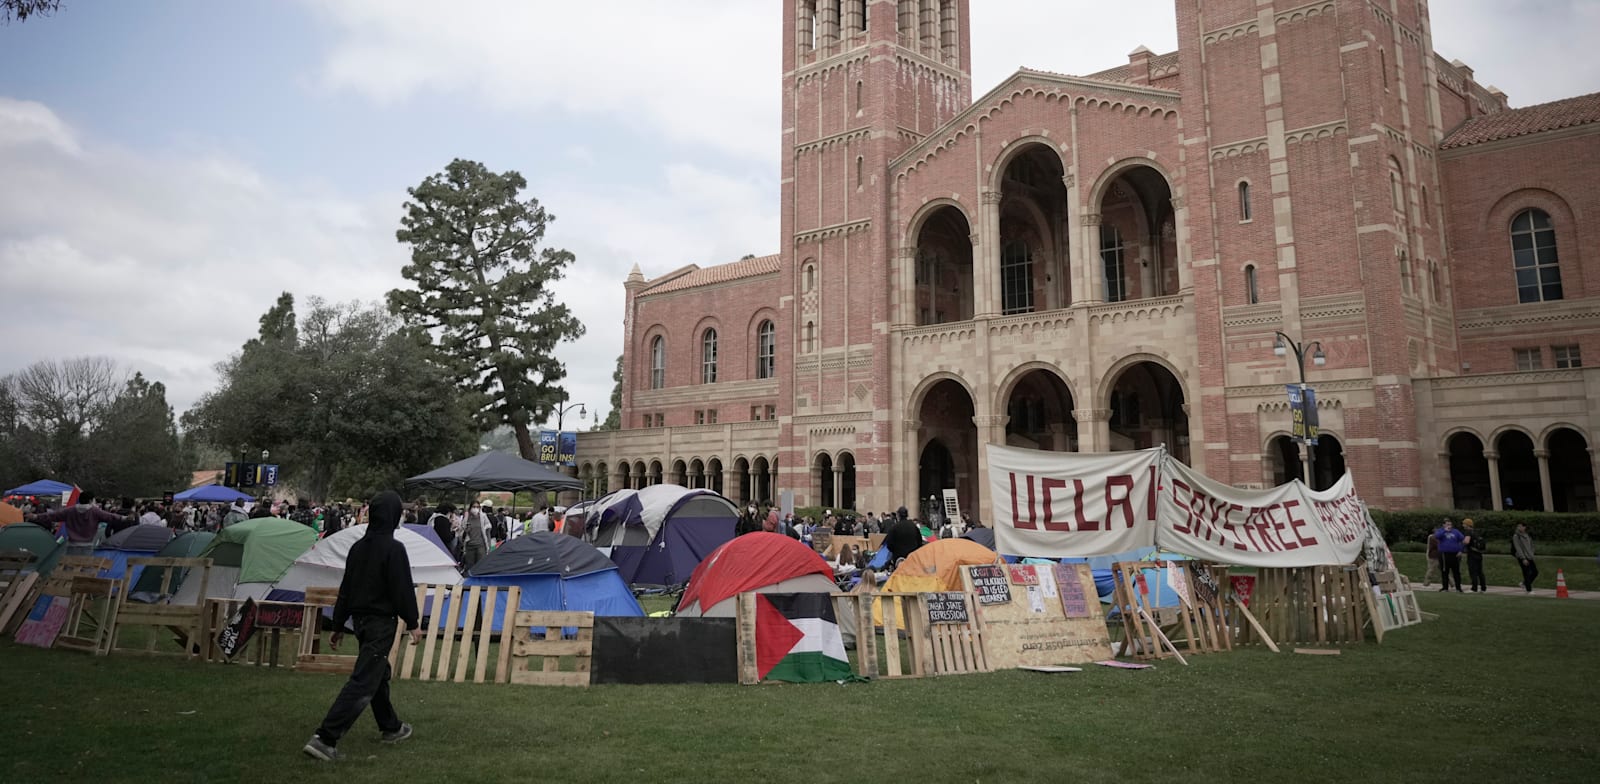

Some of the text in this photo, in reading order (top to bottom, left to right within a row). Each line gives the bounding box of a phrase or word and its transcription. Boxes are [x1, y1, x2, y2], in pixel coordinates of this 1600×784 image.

[1294, 409, 1303, 422] GO
[541, 445, 554, 453] GO
[267, 466, 276, 484] UCLA
[1009, 471, 1134, 531] UCLA
[1243, 499, 1319, 552] FREE
[224, 628, 240, 655] REAL
